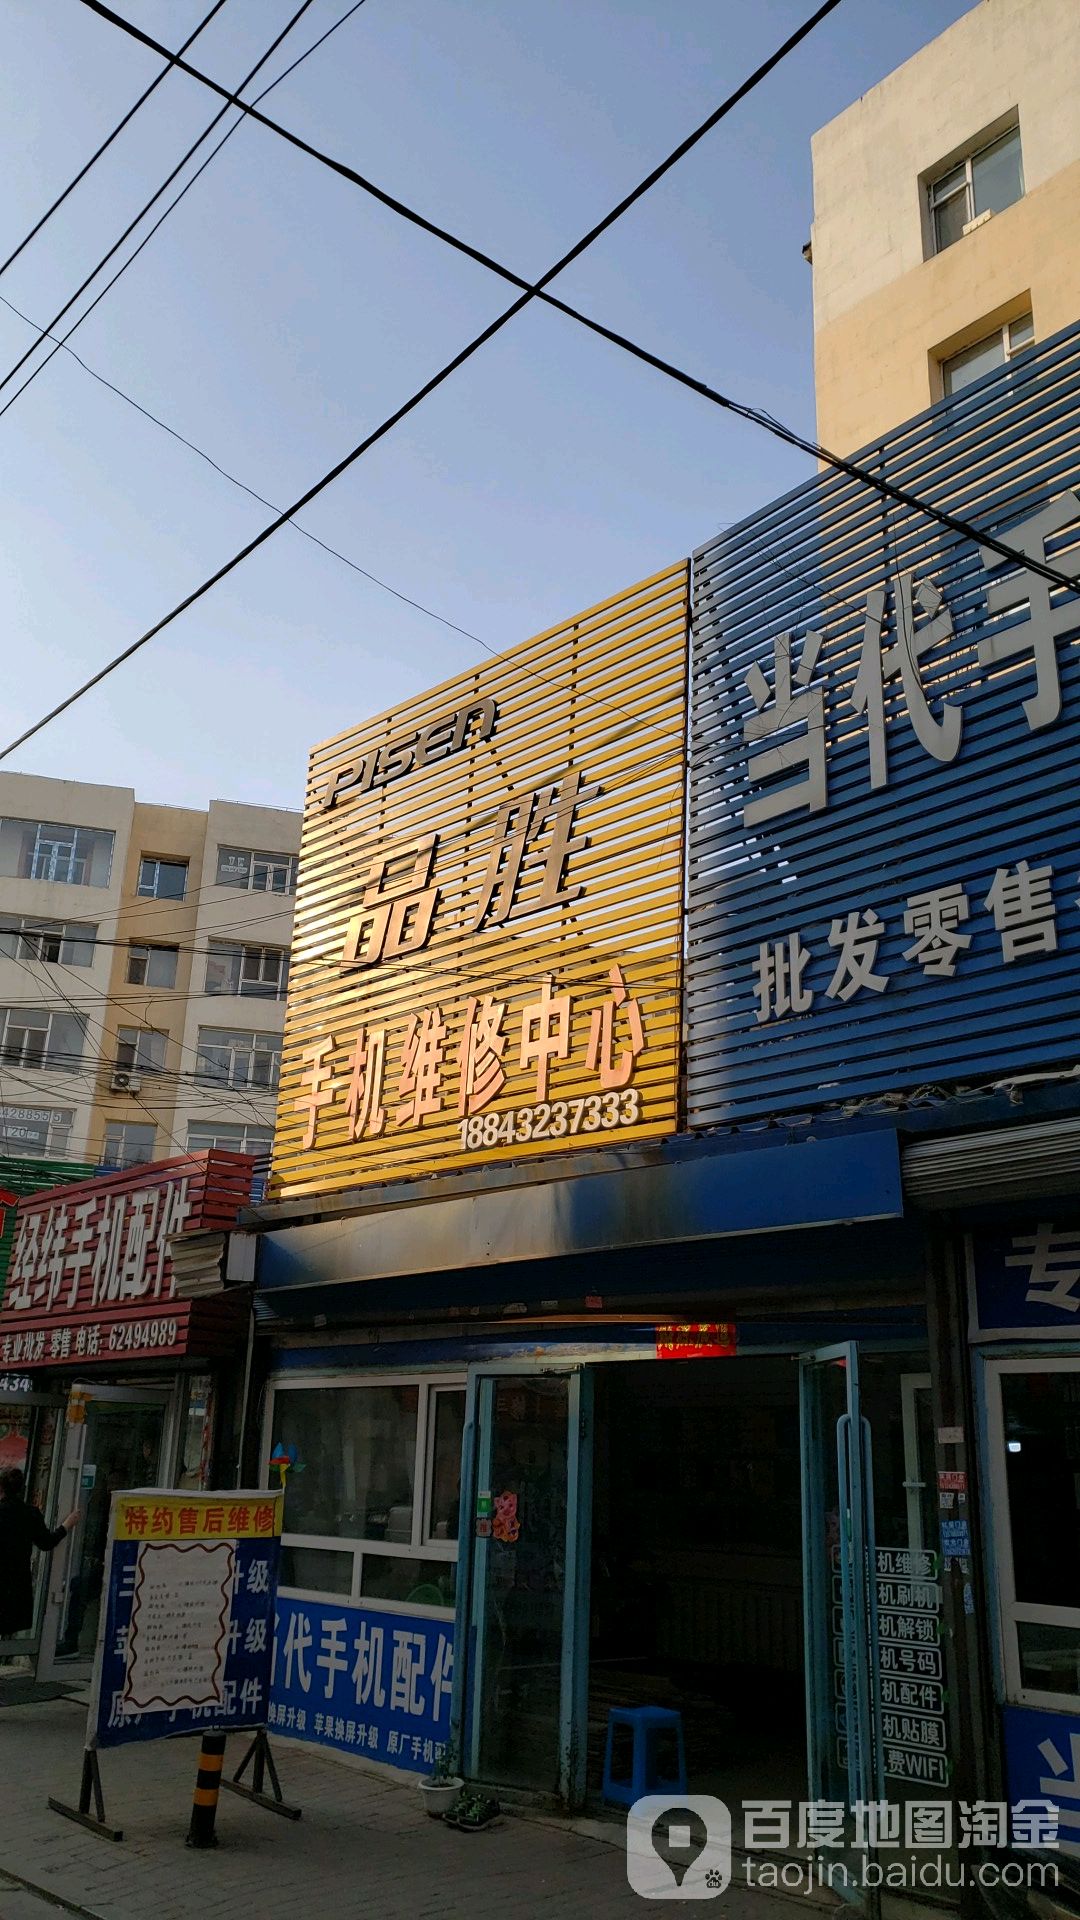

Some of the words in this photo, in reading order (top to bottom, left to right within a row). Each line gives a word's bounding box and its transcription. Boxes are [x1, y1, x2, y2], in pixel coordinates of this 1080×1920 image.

[341, 772, 602, 970] 品胜
[751, 859, 1080, 1023] 批发零售
[294, 964, 645, 1149] 手机维修中心
[0, 1107, 62, 1123] 4288555
[457, 1088, 640, 1150] 18843237333
[109, 1319, 178, 1351] 62494989
[125, 1505, 275, 1535] 特约售后维修
[877, 1551, 932, 1576] 机维修
[878, 1583, 934, 1609] 机刷机
[879, 1615, 935, 1642] 机解锁
[880, 1647, 936, 1675] 机号码
[881, 1680, 938, 1709] 机配件
[883, 1714, 940, 1746] 机贴膜
[883, 1748, 944, 1782] 费WIFI
